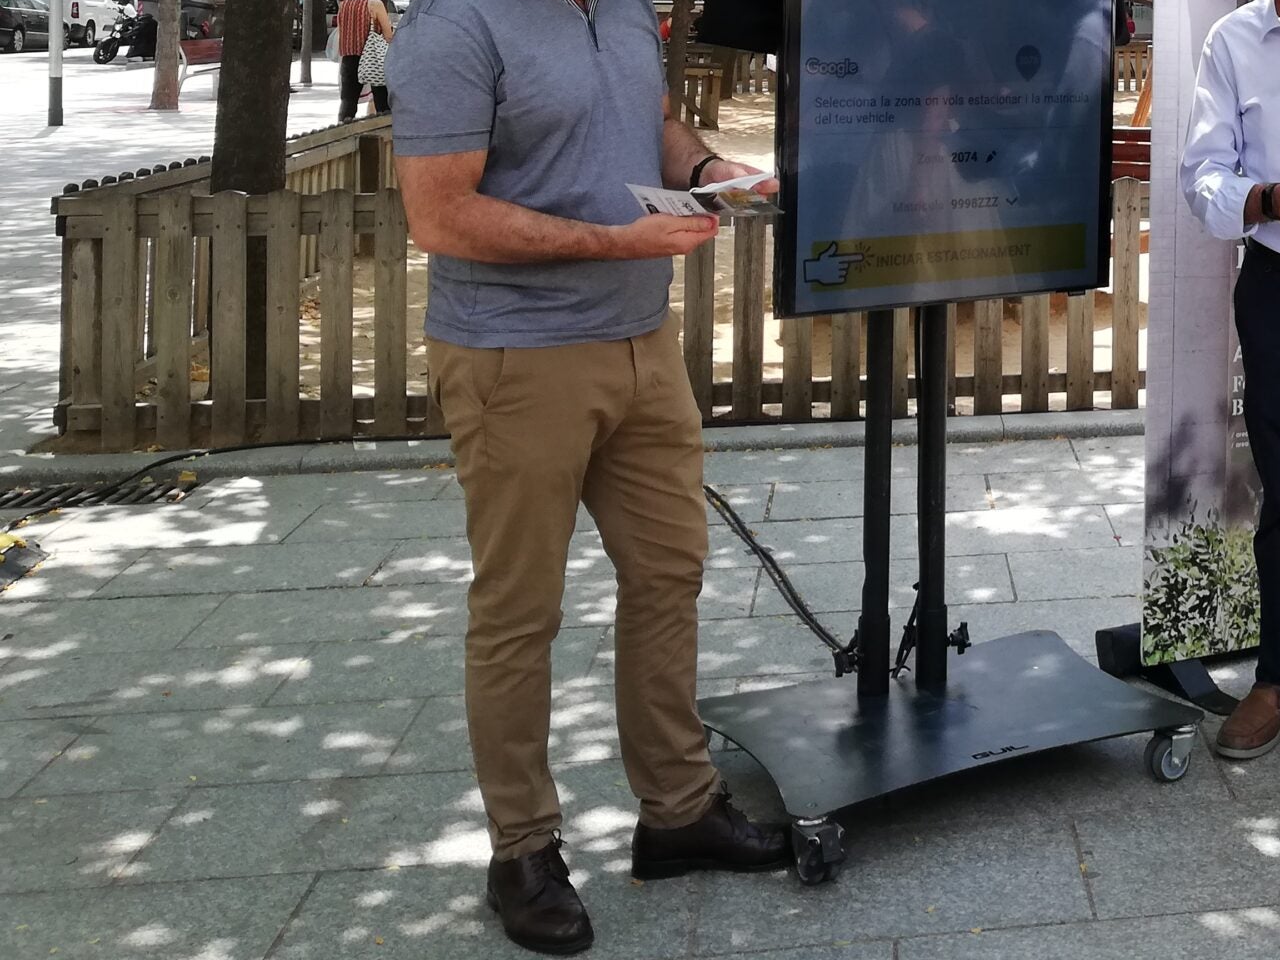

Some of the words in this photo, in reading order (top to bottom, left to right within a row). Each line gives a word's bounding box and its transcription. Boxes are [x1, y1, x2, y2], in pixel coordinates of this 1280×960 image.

[804, 57, 859, 78] Google
[815, 96, 877, 108] Selecciona
[881, 96, 890, 107] la
[894, 97, 921, 107] zona
[943, 94, 964, 106] vols
[968, 93, 1021, 105] estacionar
[814, 113, 832, 125] del
[836, 112, 853, 124] teu
[856, 112, 895, 124] vehicle
[951, 151, 978, 163] 2074
[876, 252, 924, 268] INICIAR
[927, 243, 1032, 264] ESTACIONAMENT
[971, 745, 1029, 760] GUIL
